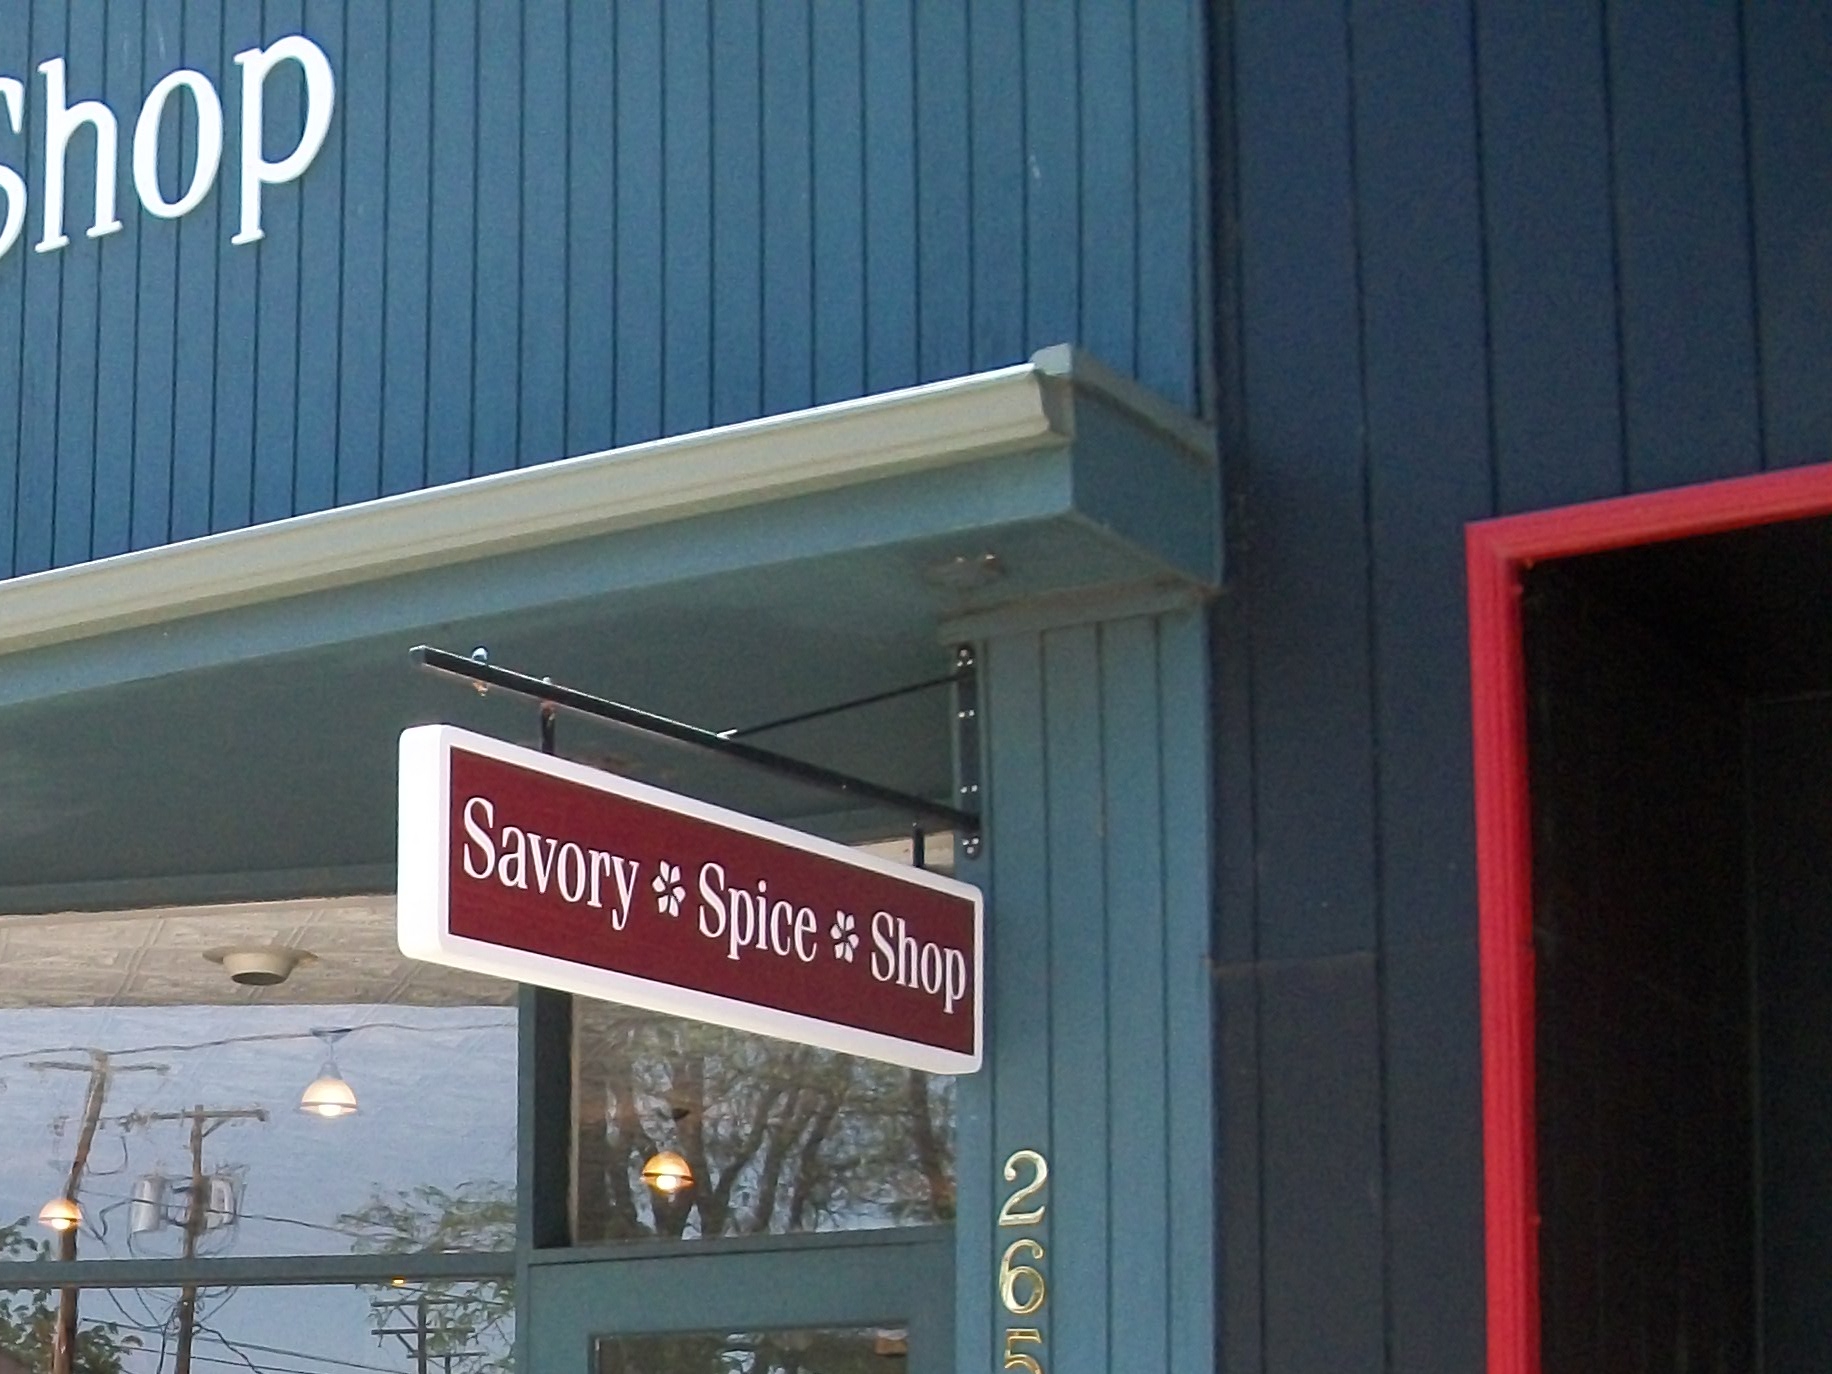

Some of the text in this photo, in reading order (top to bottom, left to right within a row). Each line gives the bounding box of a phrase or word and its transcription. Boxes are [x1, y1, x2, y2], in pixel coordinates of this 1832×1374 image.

[462, 796, 967, 1014] Savory Spice Shop
